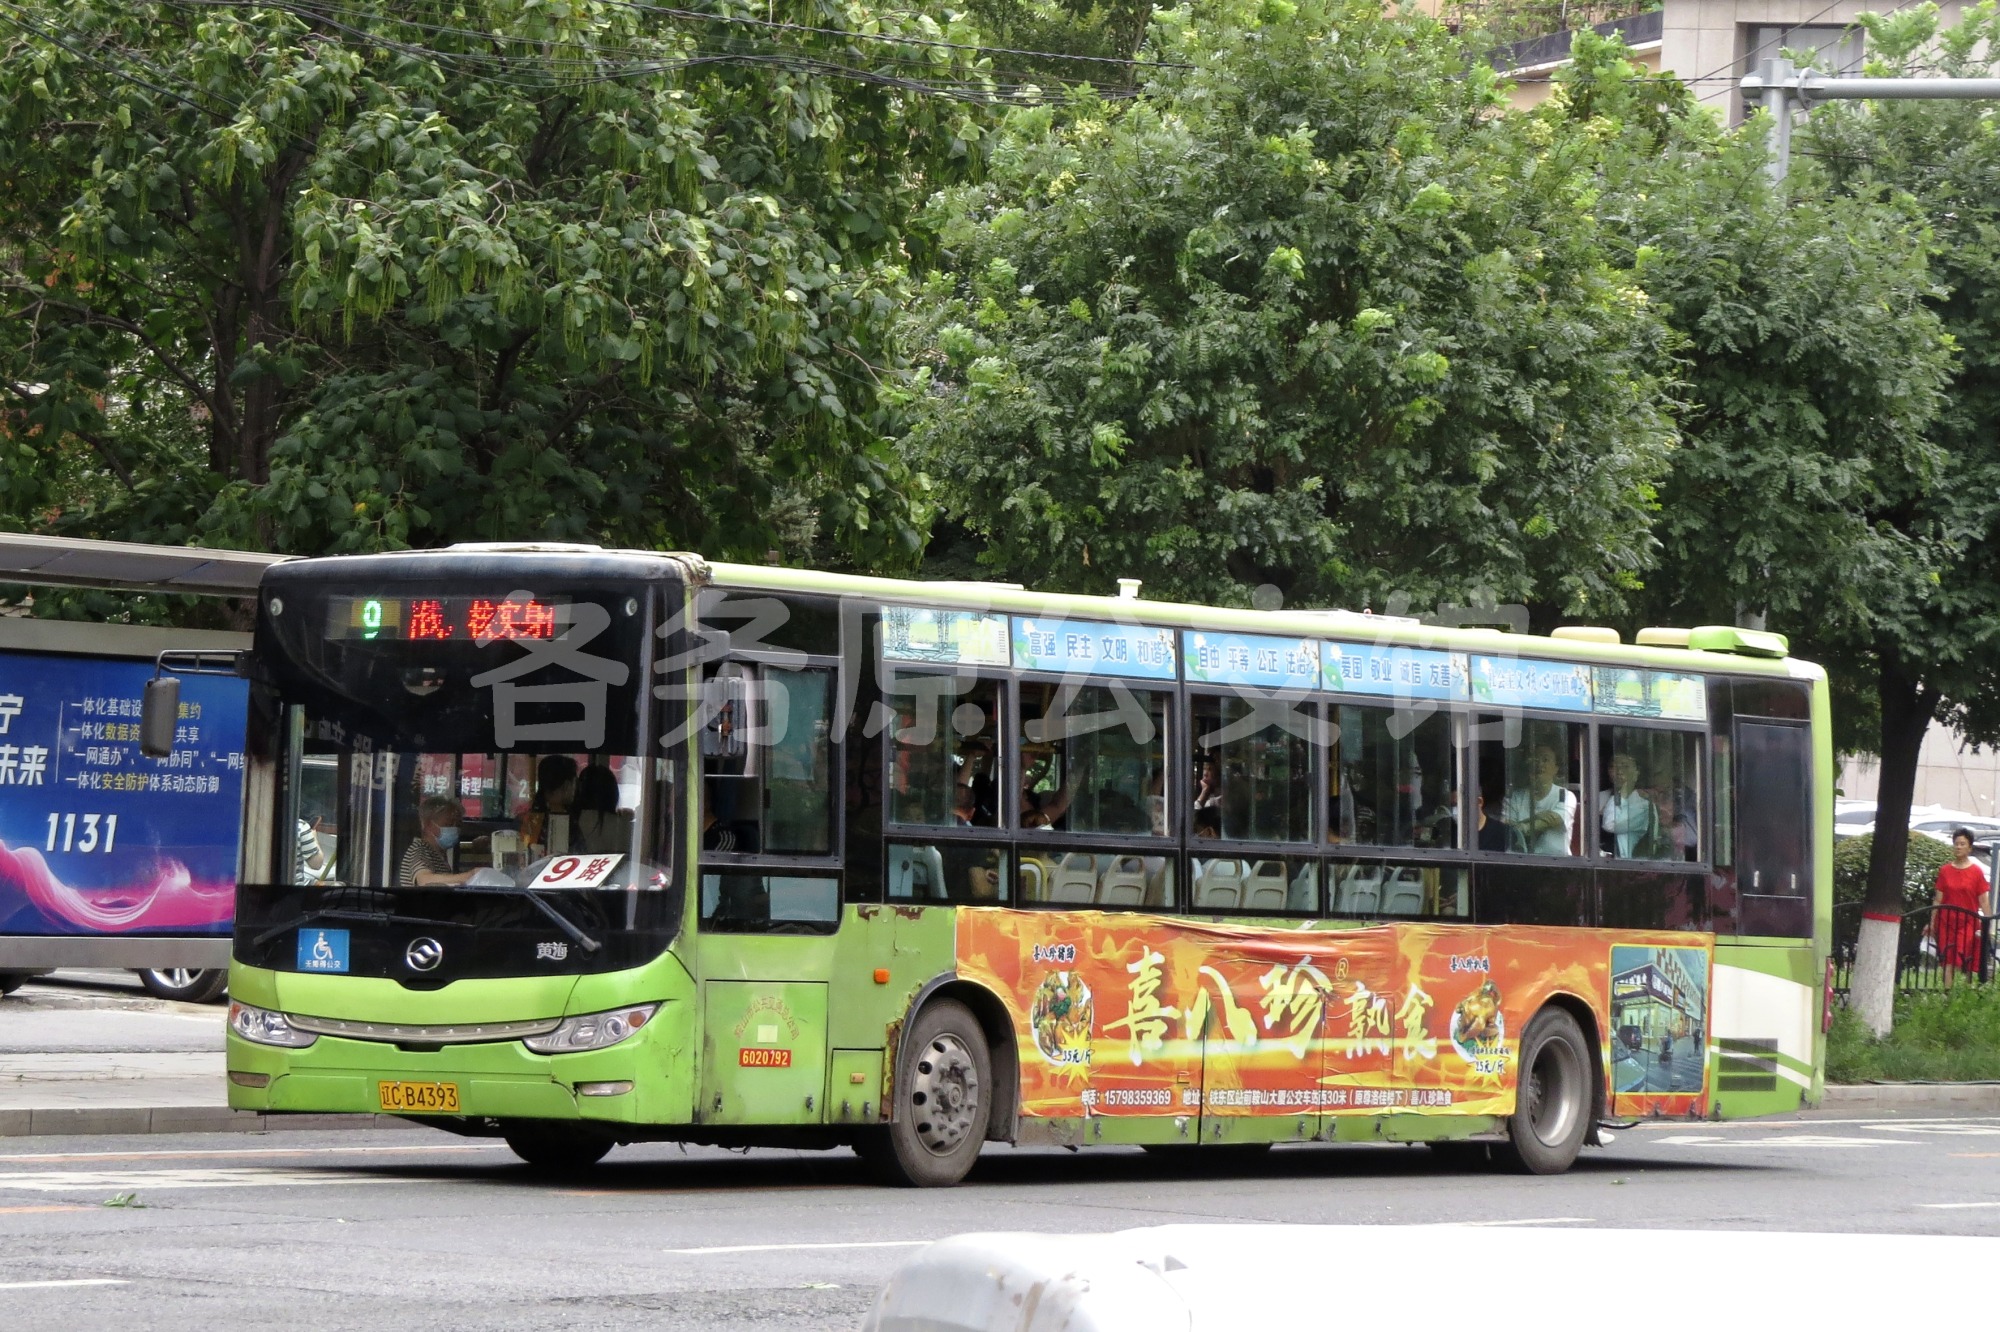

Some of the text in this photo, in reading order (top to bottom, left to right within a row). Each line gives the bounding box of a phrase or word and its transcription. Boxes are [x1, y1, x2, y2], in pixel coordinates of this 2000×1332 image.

[1029, 631, 1057, 657] 富强
[1066, 633, 1093, 660] 民主
[1101, 635, 1128, 662] 文明
[1136, 637, 1165, 666] 和谐
[1198, 645, 1307, 675] 自由 平等 公正 法治
[1341, 655, 1451, 688] 爱国 敬业 诚信 友善
[65, 771, 220, 794] 一体化安全防护体系动态防御
[46, 812, 118, 853] 1131
[537, 942, 568, 961] 黄海
[742, 1050, 789, 1066] 6020792
